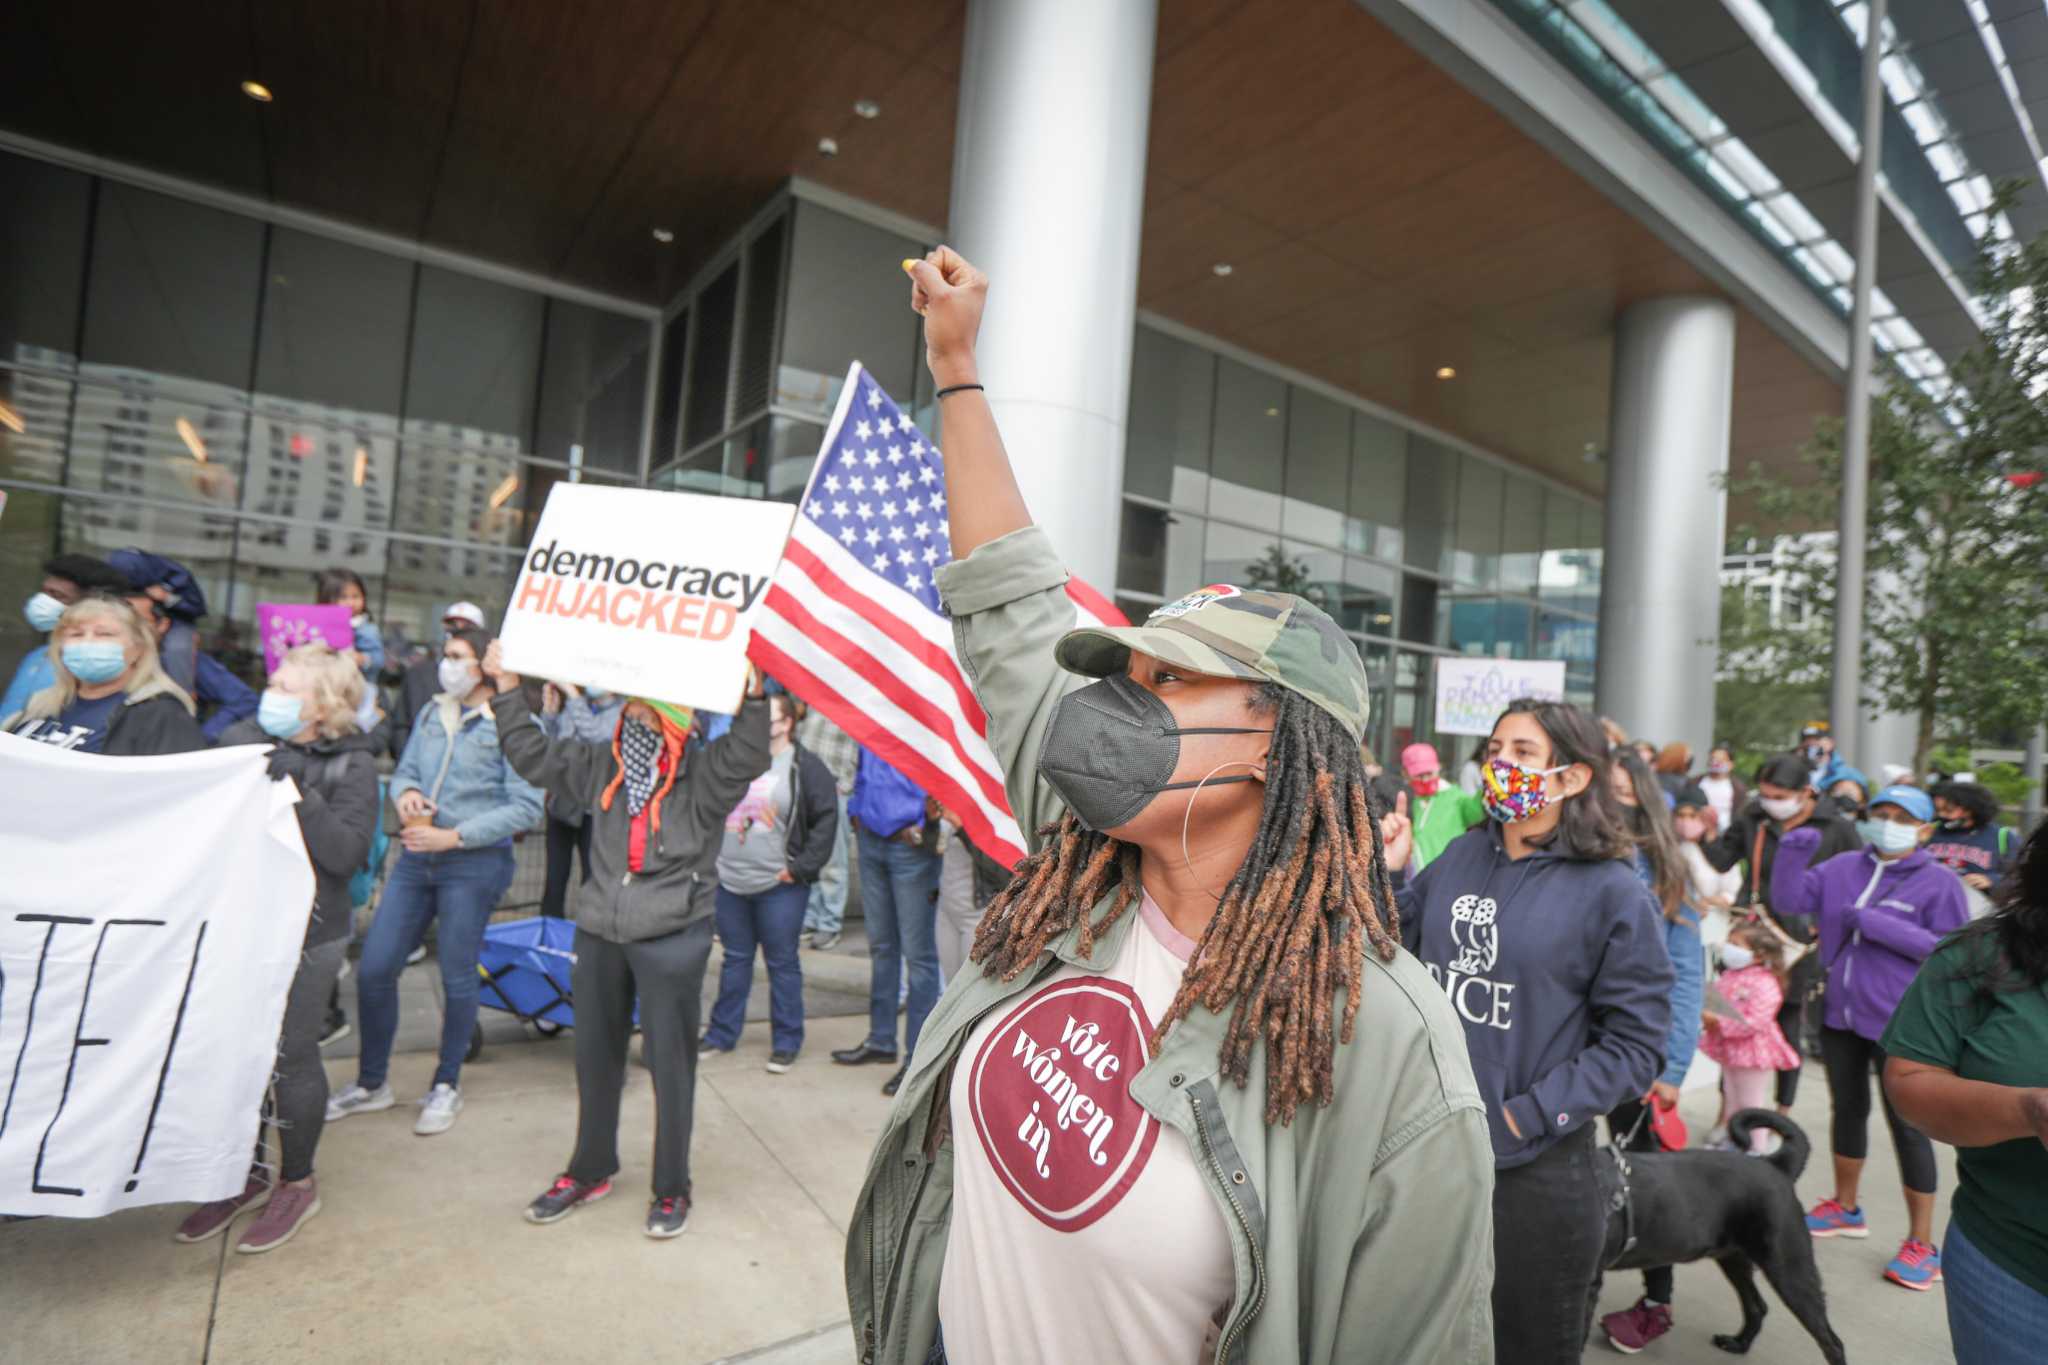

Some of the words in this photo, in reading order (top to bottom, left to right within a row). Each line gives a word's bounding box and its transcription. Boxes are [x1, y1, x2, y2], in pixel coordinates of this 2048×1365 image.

[516, 575, 737, 642] HIJACKED
[529, 539, 769, 613] democracy
[0, 913, 208, 1196] TE!
[1060, 1014, 1120, 1081] vote
[1012, 1028, 1114, 1166] women
[1018, 1100, 1051, 1179] in
